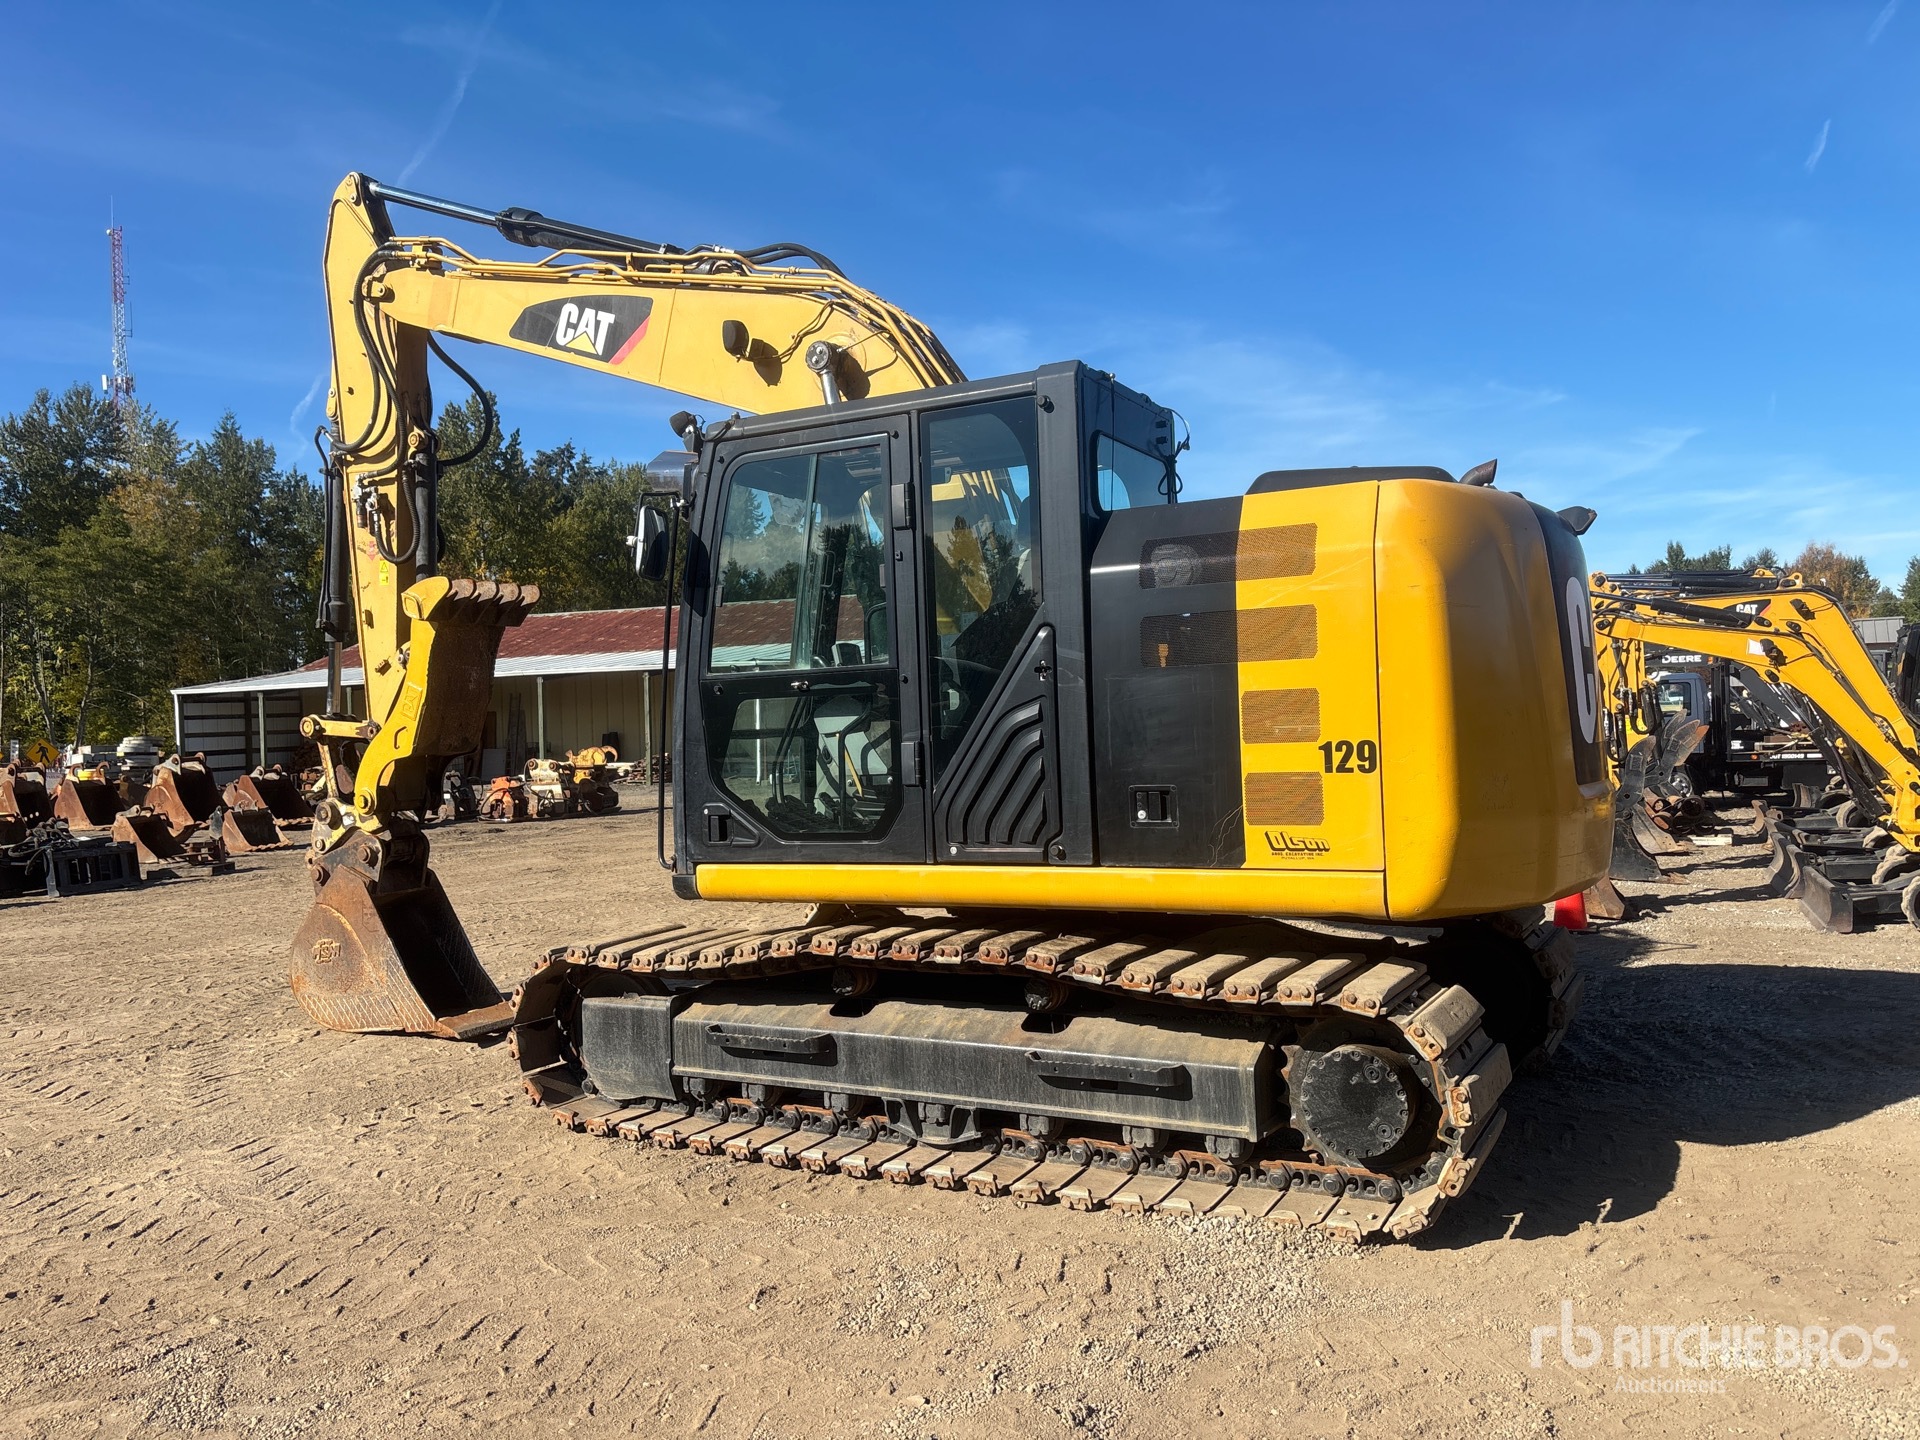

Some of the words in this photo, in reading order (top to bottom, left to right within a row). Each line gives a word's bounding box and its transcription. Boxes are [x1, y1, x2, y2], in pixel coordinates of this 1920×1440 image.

[555, 302, 616, 356] CAT
[1735, 603, 1758, 615] CAT
[1661, 654, 1702, 664] DEERE
[1318, 739, 1378, 774] 129
[1264, 830, 1331, 852] Olson
